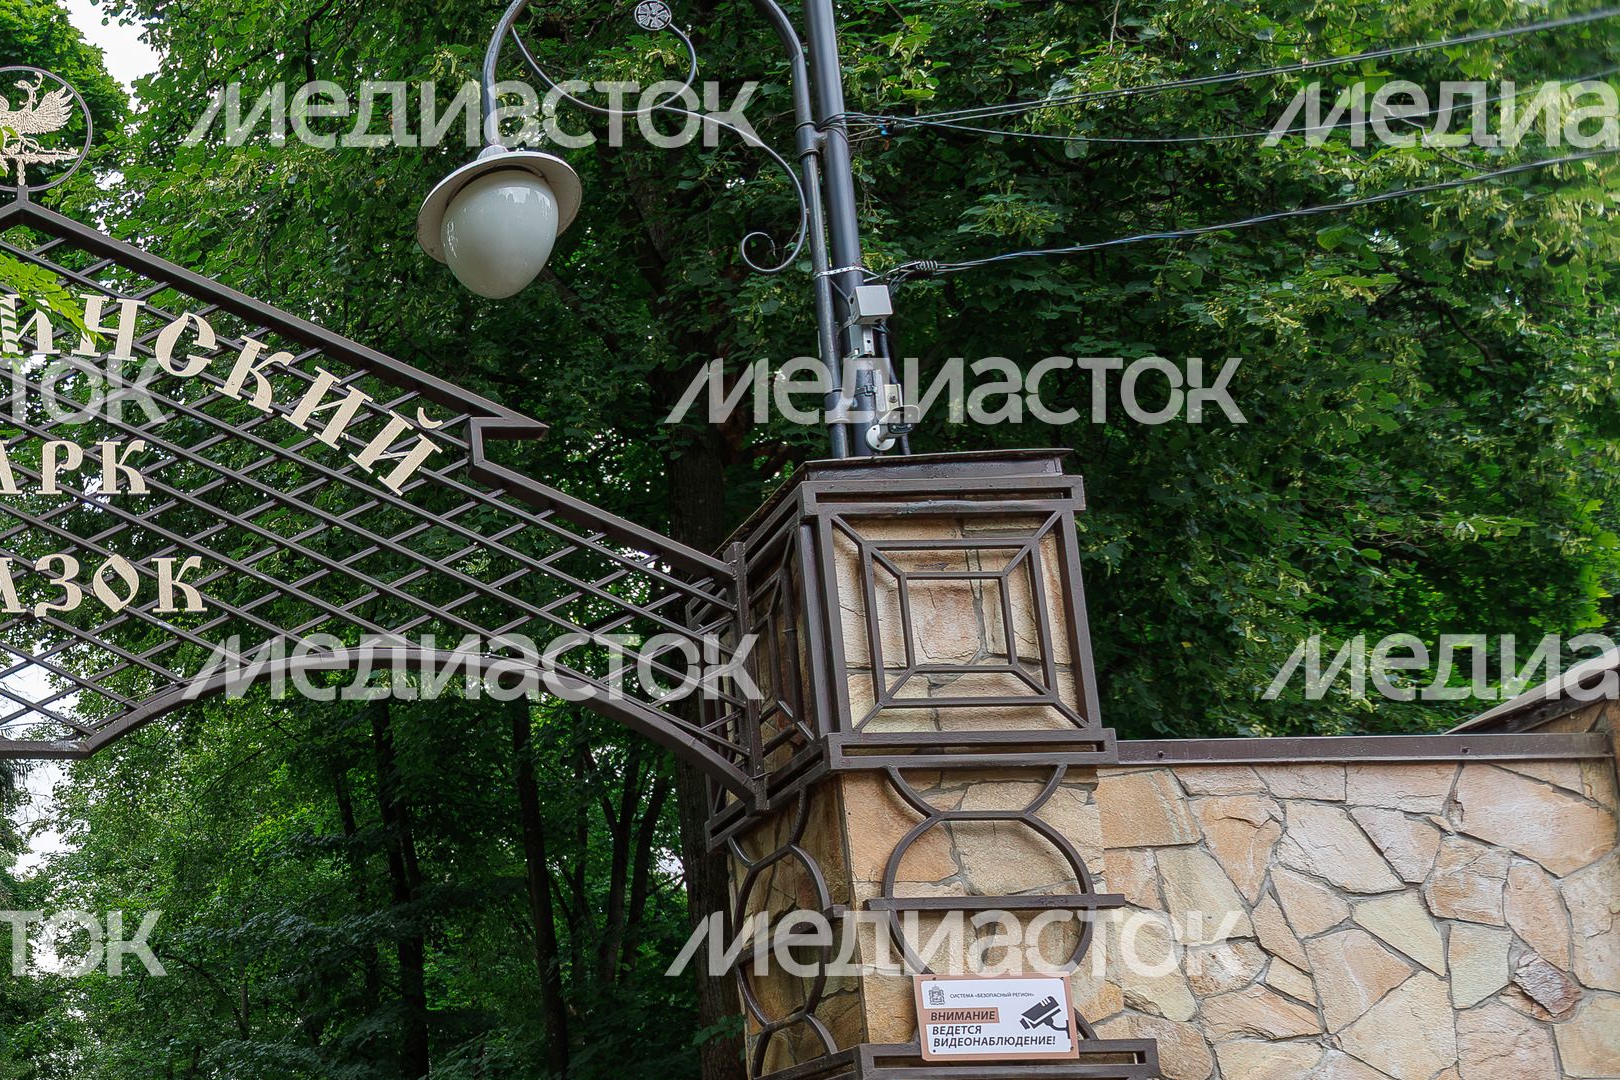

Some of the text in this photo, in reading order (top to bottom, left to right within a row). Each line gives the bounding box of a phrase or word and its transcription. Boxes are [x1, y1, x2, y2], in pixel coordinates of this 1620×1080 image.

[930, 1010, 996, 1021] ВНИМАНИЕ
[932, 1025, 982, 1036] ВЕДЕТСЯ
[933, 1035, 1056, 1048] ВИДЕОНАБЛЮДЕНИЕ!
